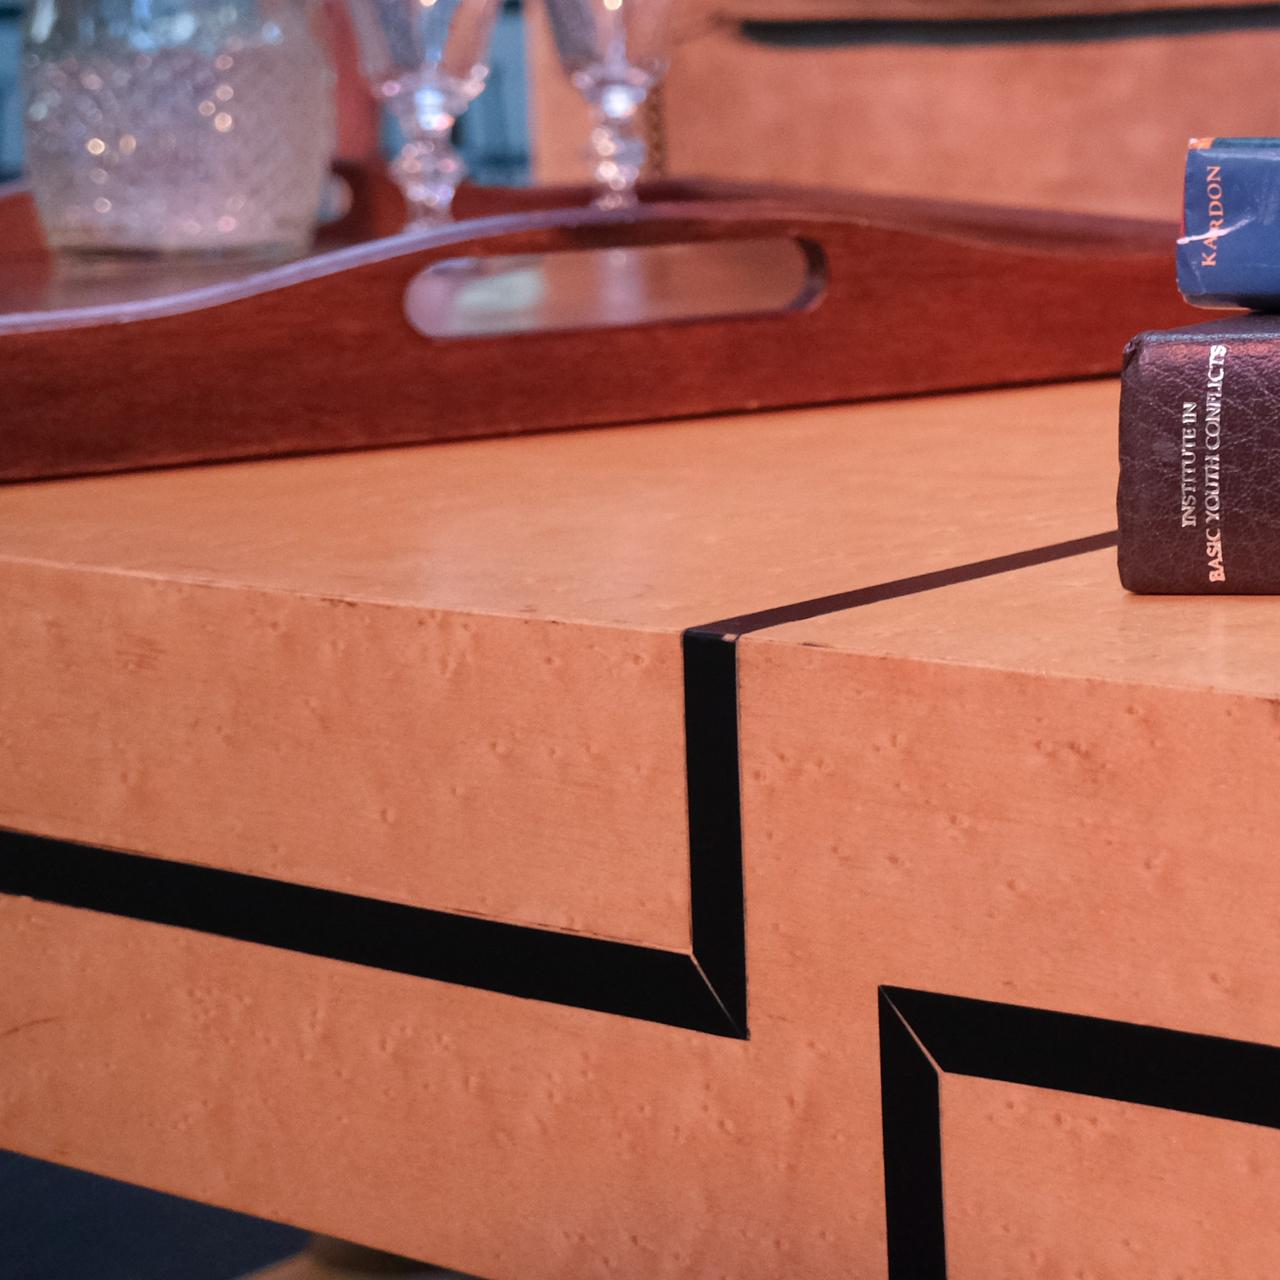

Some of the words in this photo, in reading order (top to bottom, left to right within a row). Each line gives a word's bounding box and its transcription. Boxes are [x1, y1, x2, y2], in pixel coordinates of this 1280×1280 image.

[1201, 165, 1225, 267] KARDON
[1182, 401, 1198, 424] IN
[1205, 344, 1228, 452] CONFLICTS
[1181, 427, 1198, 528] INSTITUTE
[1204, 453, 1220, 524] YOUTH
[1206, 528, 1226, 582] BASIC
